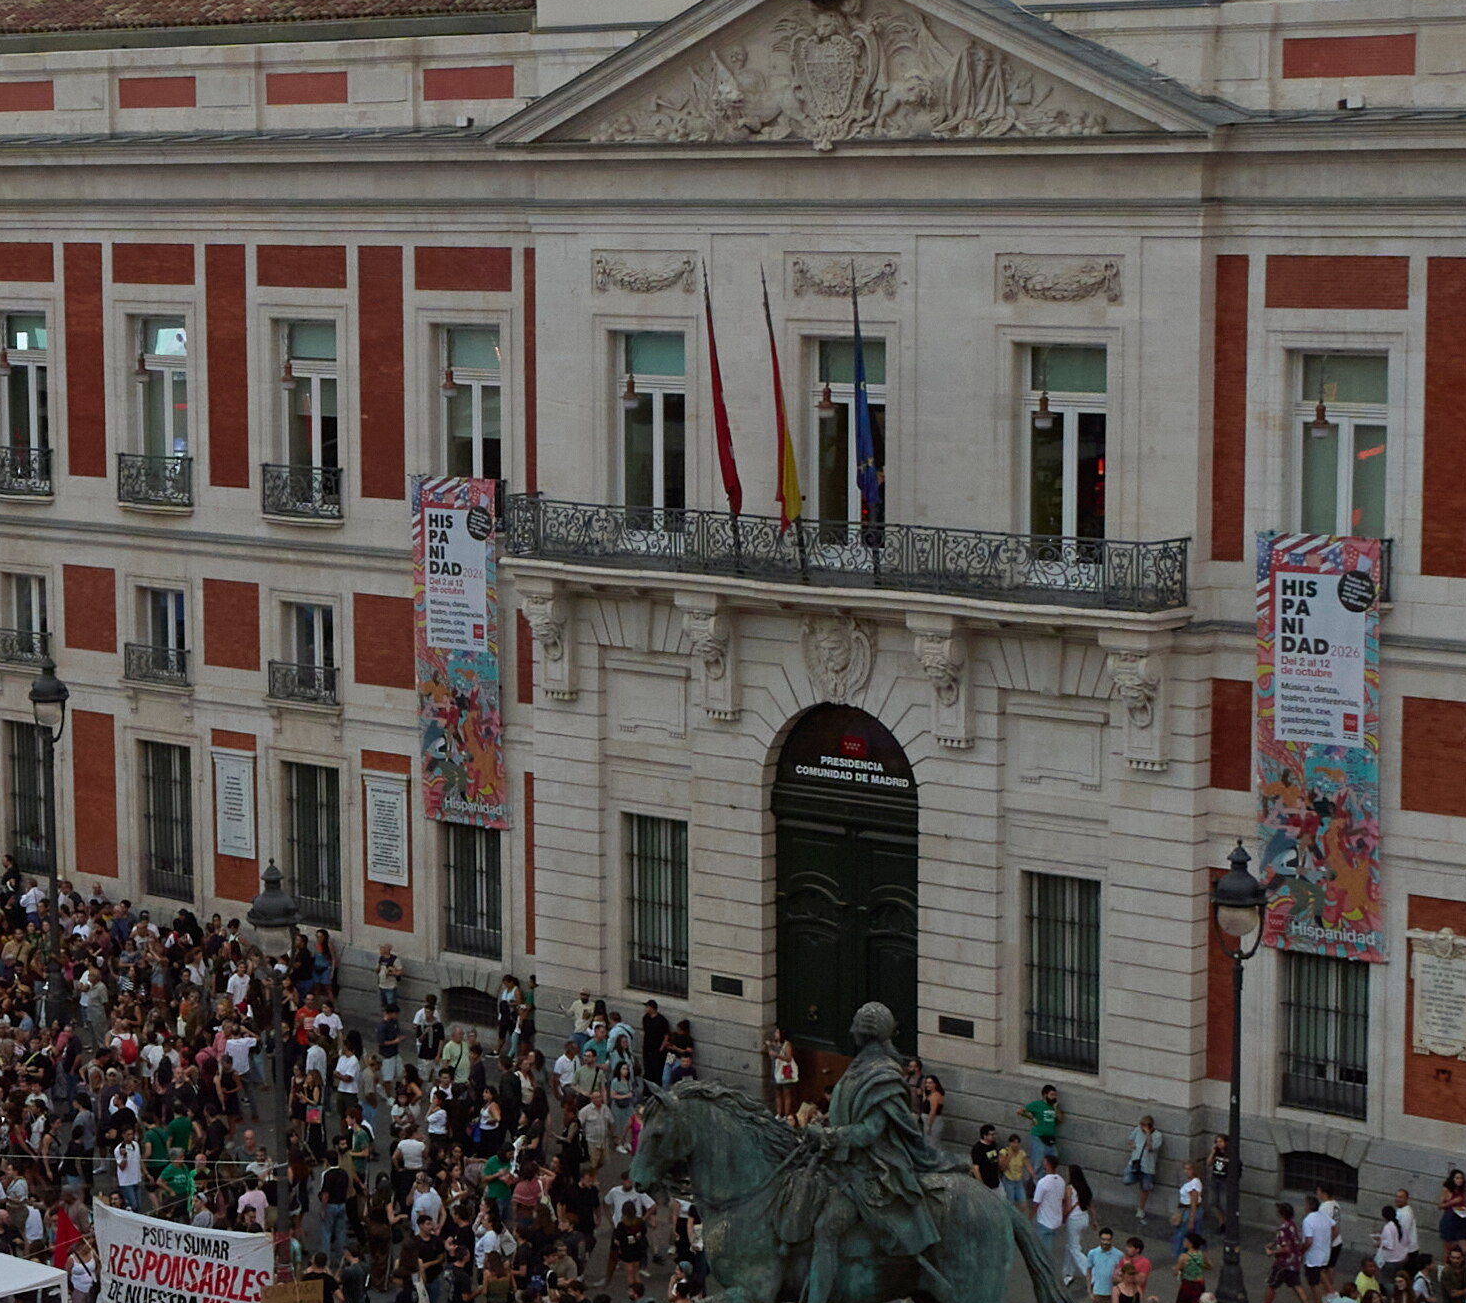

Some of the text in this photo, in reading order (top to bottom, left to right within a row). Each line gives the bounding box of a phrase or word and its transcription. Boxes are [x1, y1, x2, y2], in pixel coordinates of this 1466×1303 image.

[429, 514, 453, 529] HIS
[429, 530, 449, 544] PA
[429, 546, 444, 559] NI
[429, 561, 462, 576] DAD
[1281, 579, 1318, 597] HIS
[1281, 598, 1311, 616] PA
[1281, 618, 1304, 635] NI
[1281, 636, 1360, 658] DAD 2026
[1281, 656, 1330, 668] Del 2 al 12
[1281, 667, 1332, 678] de octubre
[820, 756, 883, 772] PRESIDENCIA
[795, 765, 909, 787] COMUNIDAD DE MADRID
[444, 795, 502, 816] Hispanidad
[1290, 919, 1376, 947] Hispanidad
[142, 1226, 229, 1261] PSOE Y SUMAR
[107, 1244, 271, 1302] RESPONSABLES
